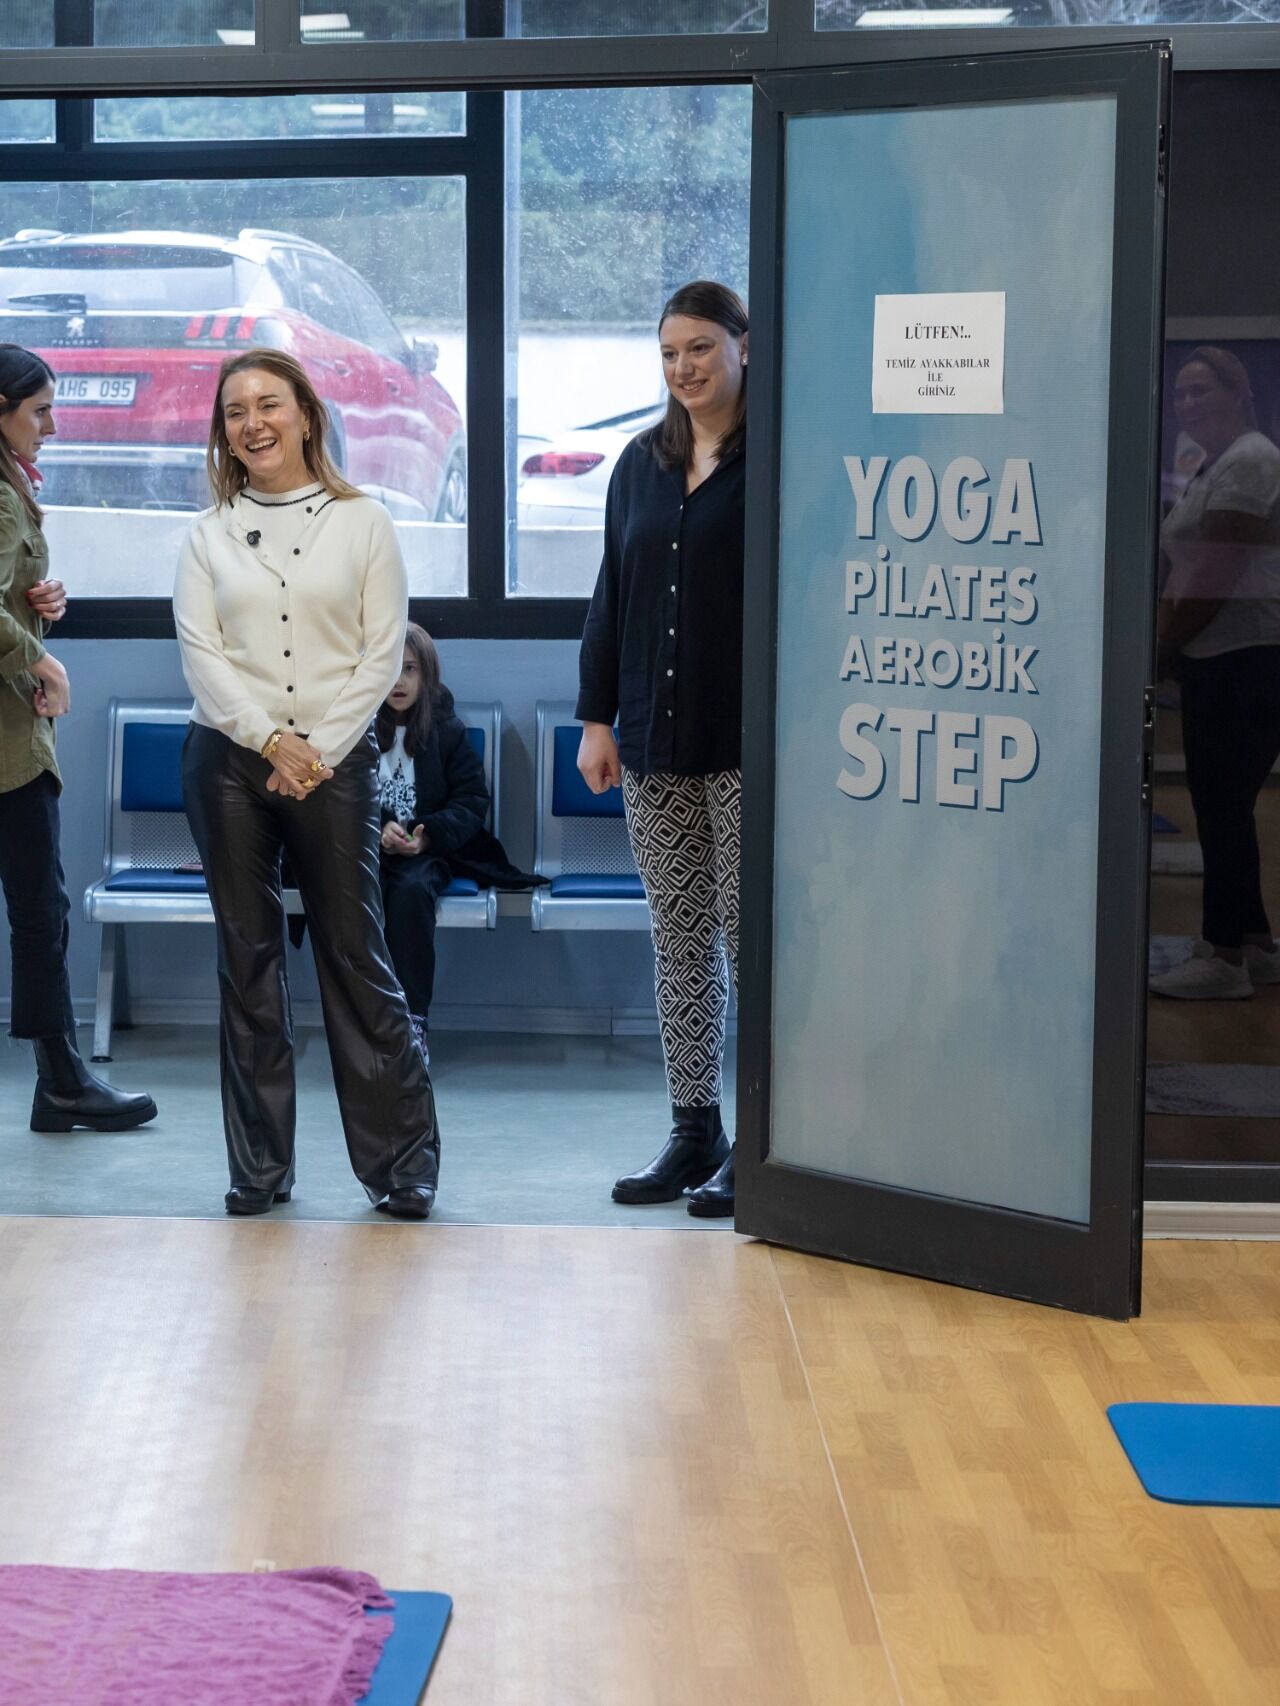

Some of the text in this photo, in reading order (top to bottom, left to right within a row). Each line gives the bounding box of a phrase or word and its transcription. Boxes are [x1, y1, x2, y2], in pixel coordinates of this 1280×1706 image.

[904, 322, 971, 340] LÜTFEN!..
[885, 356, 991, 369] TEMİZ AYAKKABILAR
[927, 370, 944, 382] İLE
[57, 378, 132, 398] AHG 095
[917, 384, 956, 396] GİRİNİZ
[842, 455, 1043, 546] YOGA
[844, 544, 1039, 626] PİLATES
[838, 628, 1040, 695] AEROBİK
[835, 702, 1040, 812] STEP
